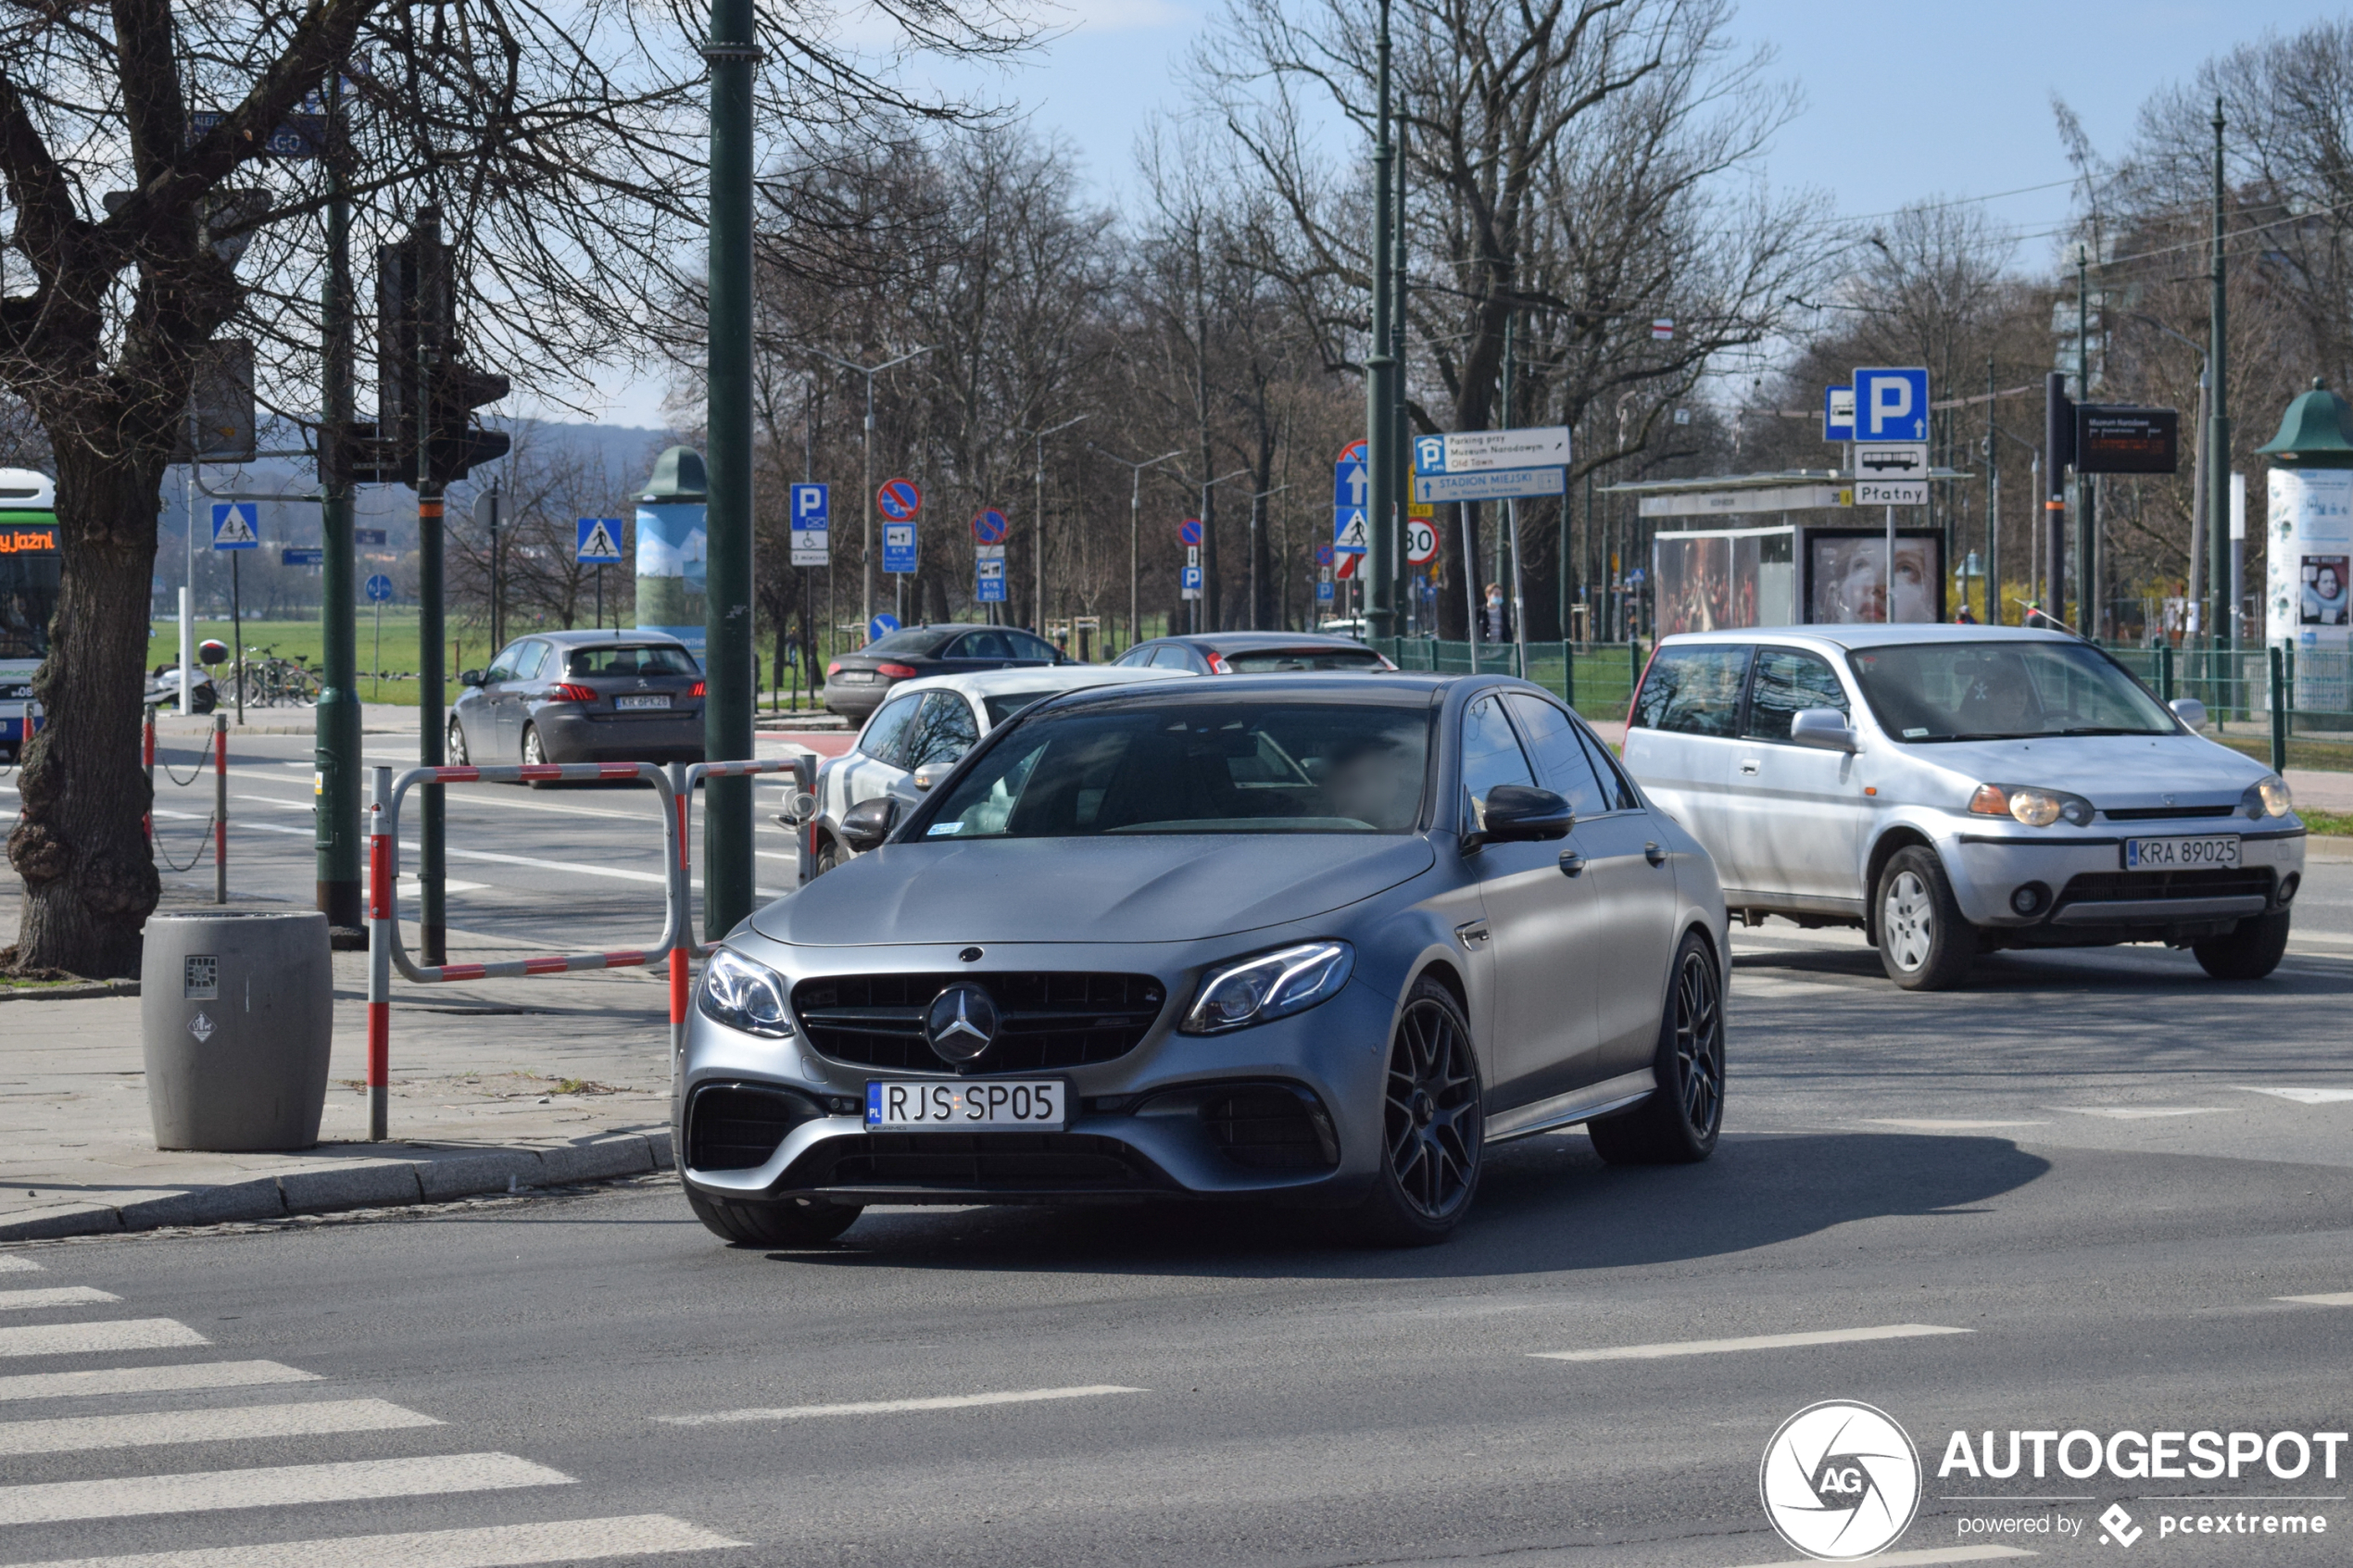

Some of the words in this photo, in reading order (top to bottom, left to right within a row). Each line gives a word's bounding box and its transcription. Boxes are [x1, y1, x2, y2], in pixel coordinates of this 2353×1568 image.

[1870, 376, 1912, 433] P
[1450, 436, 1483, 445] Parking
[1487, 434, 1505, 444] przy
[1451, 447, 1487, 456] Muzeum
[1491, 444, 1544, 453] Narodowym
[1452, 458, 1467, 468] Old
[1471, 458, 1493, 467] Town
[1440, 475, 1486, 488] STADION
[1491, 473, 1532, 484] MIEJSKI
[1862, 486, 1922, 502] Płatny
[799, 487, 822, 517] P
[1187, 570, 1200, 586] P
[622, 696, 635, 707] KR
[2138, 843, 2174, 863] KRA
[2182, 841, 2236, 862] 89025
[887, 1085, 951, 1121] RJS
[964, 1085, 1053, 1121] SP05
[869, 1108, 880, 1118] PL
